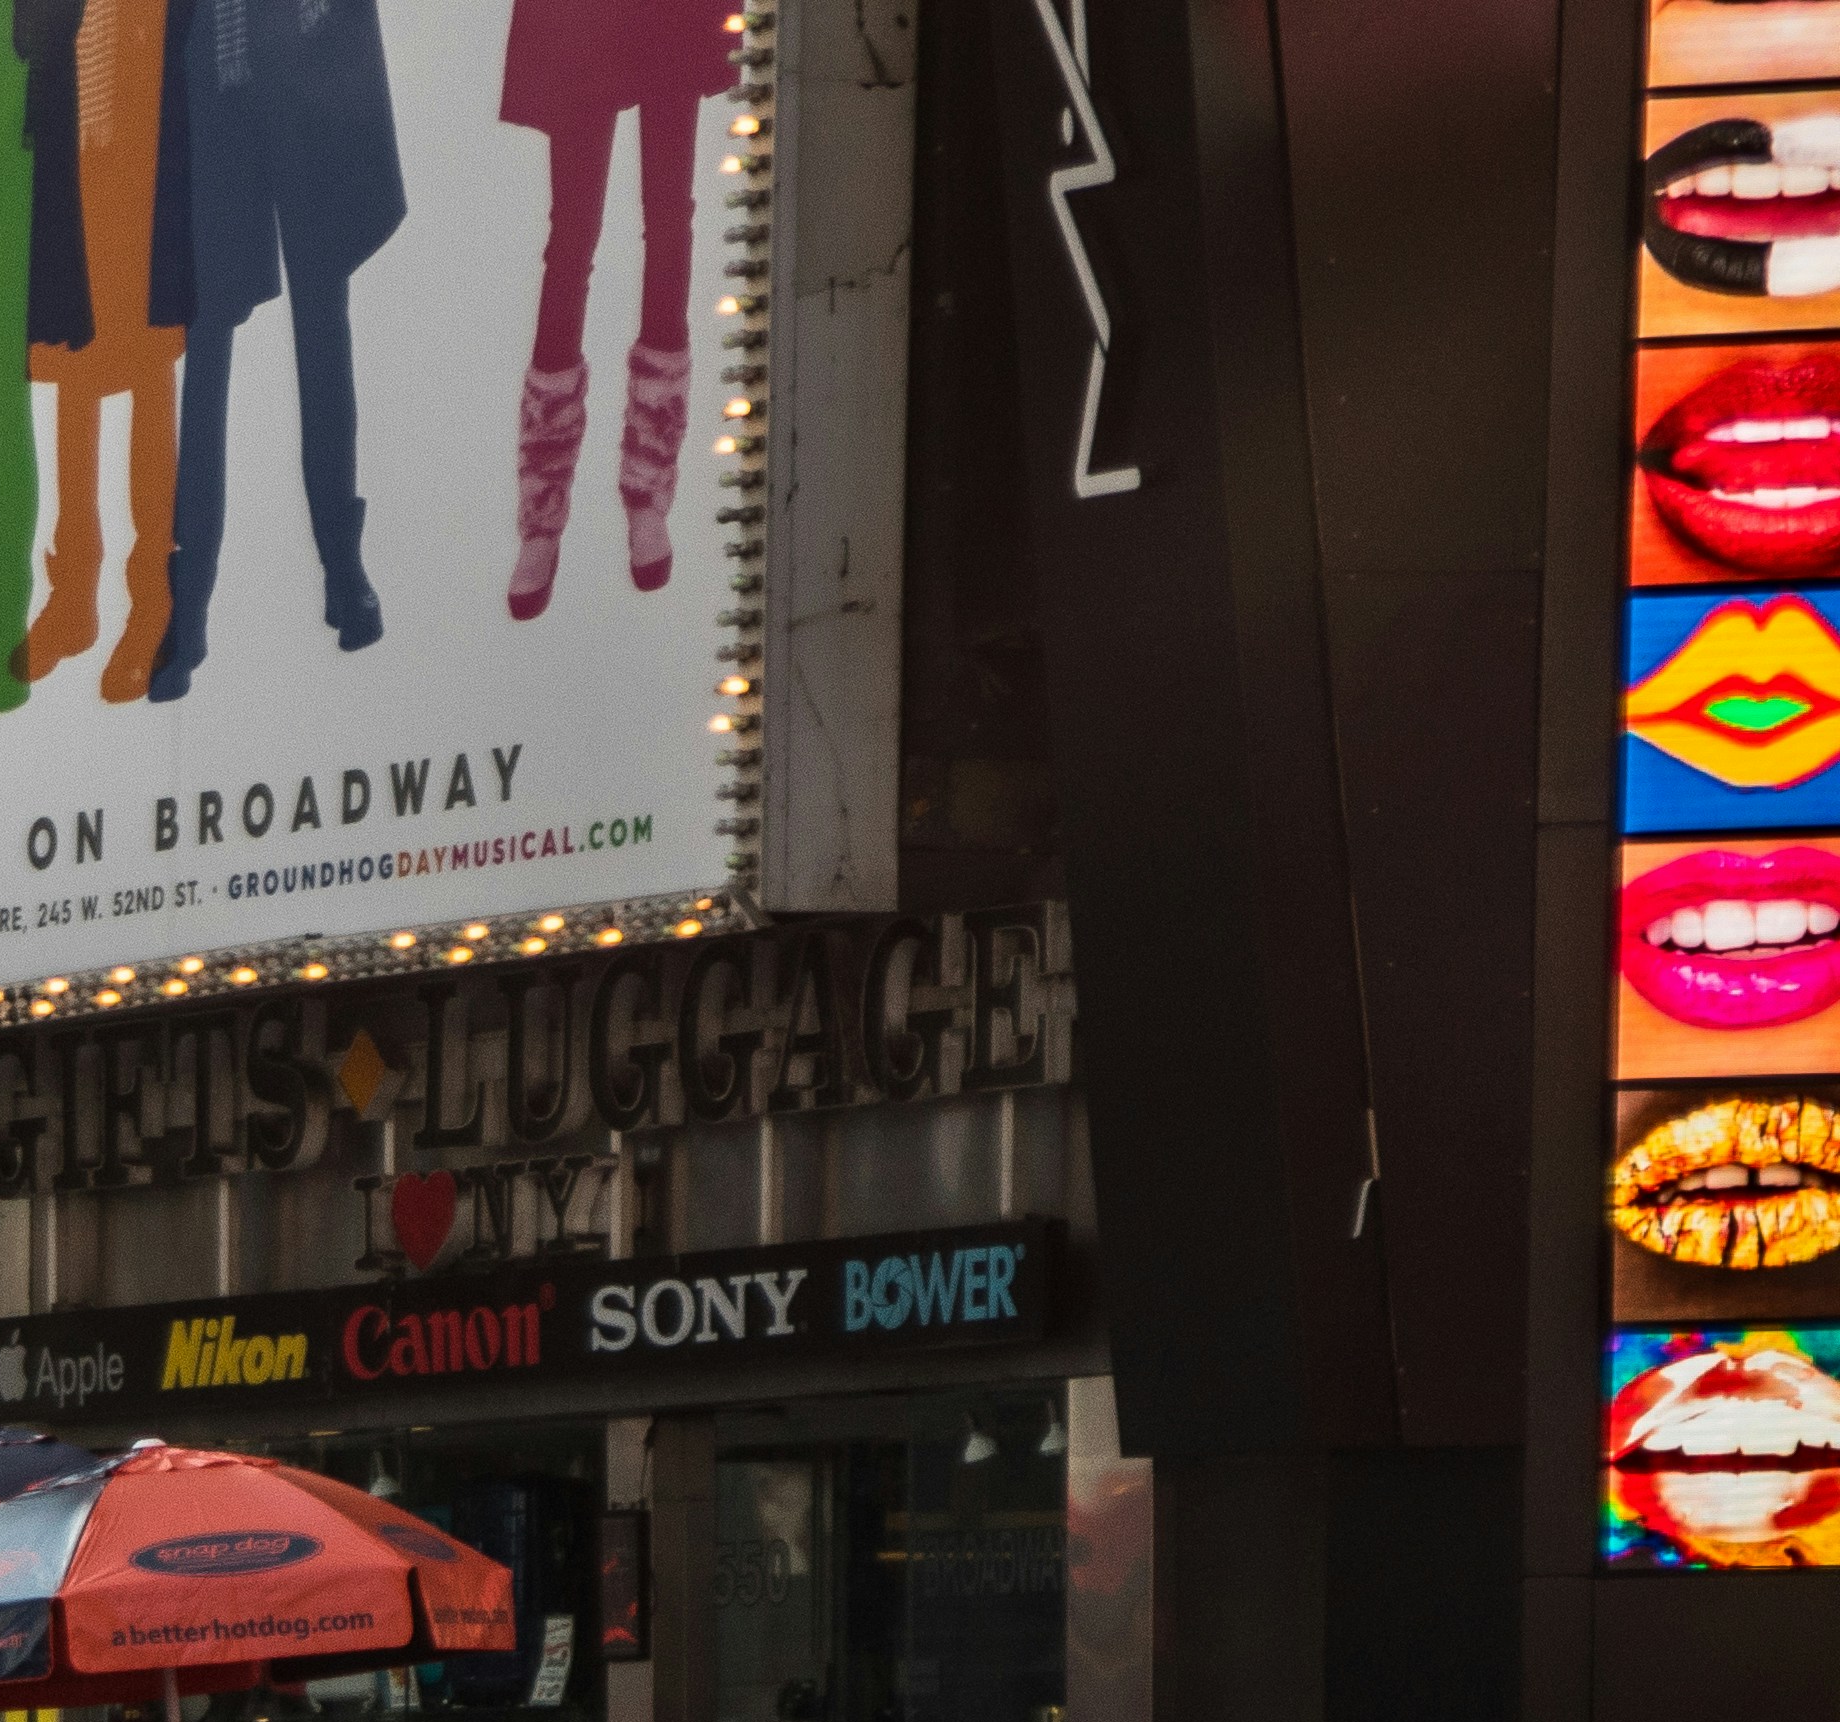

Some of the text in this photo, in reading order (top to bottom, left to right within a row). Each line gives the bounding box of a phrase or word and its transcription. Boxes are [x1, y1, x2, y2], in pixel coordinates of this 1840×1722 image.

[27, 808, 105, 871] ON
[155, 743, 523, 853] BROADWAY
[37, 900, 72, 929] 245
[80, 896, 103, 922] W.
[112, 886, 164, 917] 52ND
[174, 880, 203, 908] ST.
[228, 815, 654, 899] GROUNDHOGDAYMUSICAL.COM
[415, 903, 1073, 1150] LUGGAGE
[35, 1245, 1018, 1397] Apple Nikon Canon SONY BOWER
